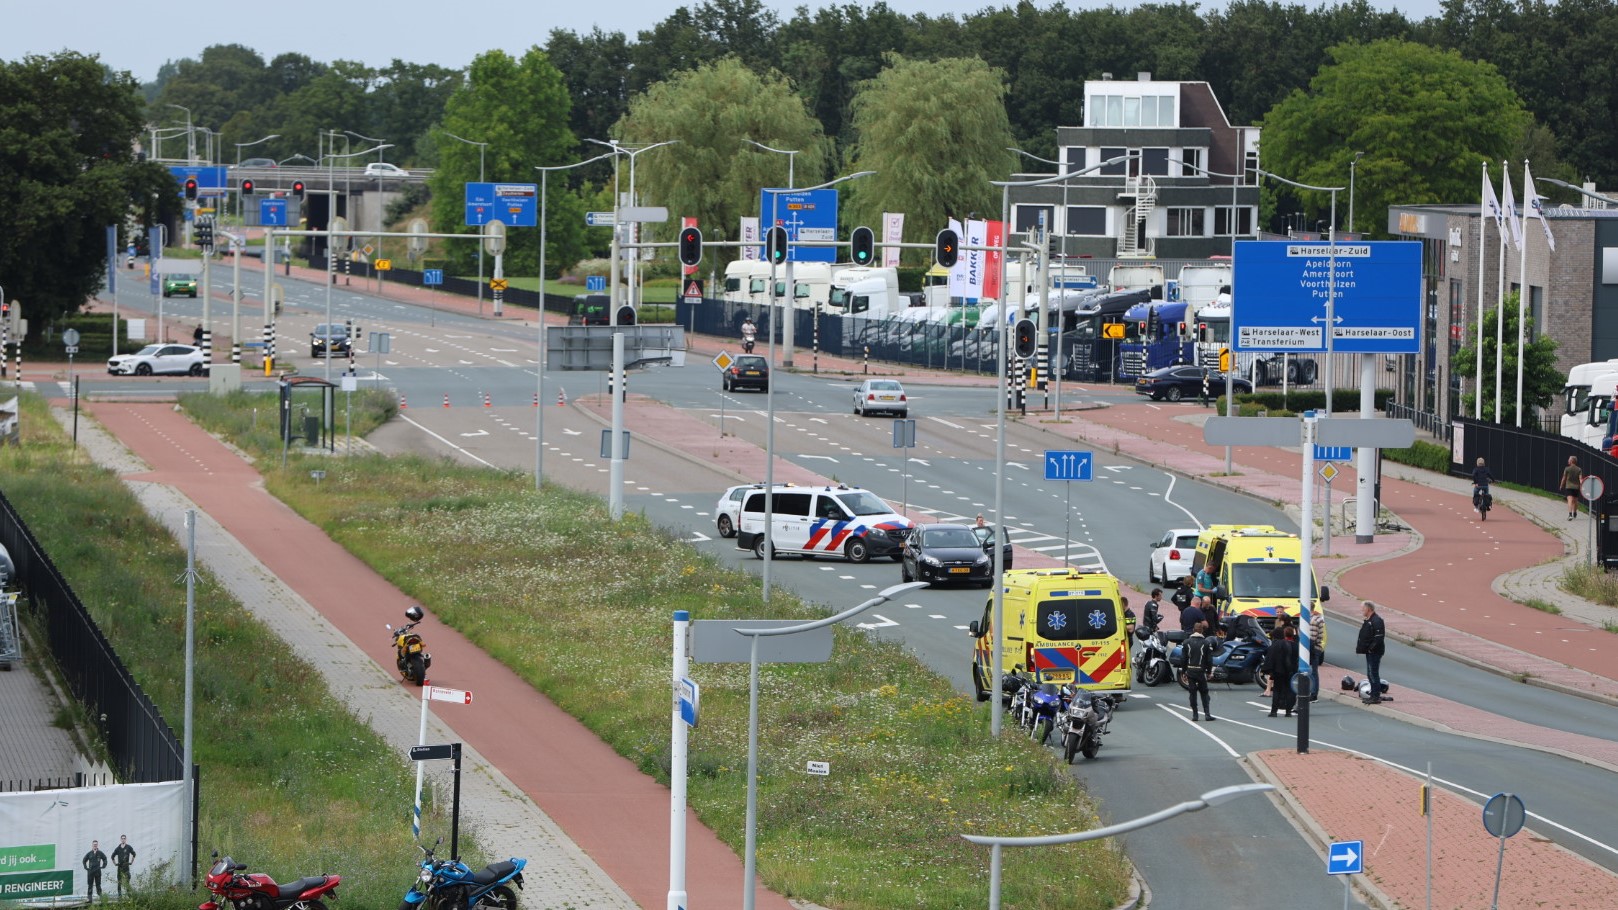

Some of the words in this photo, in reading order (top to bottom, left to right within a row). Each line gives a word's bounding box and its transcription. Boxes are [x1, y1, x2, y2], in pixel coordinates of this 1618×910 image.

[8, 855, 17, 866] jij
[20, 854, 37, 864] ook
[5, 880, 64, 894] RENGINEER?
